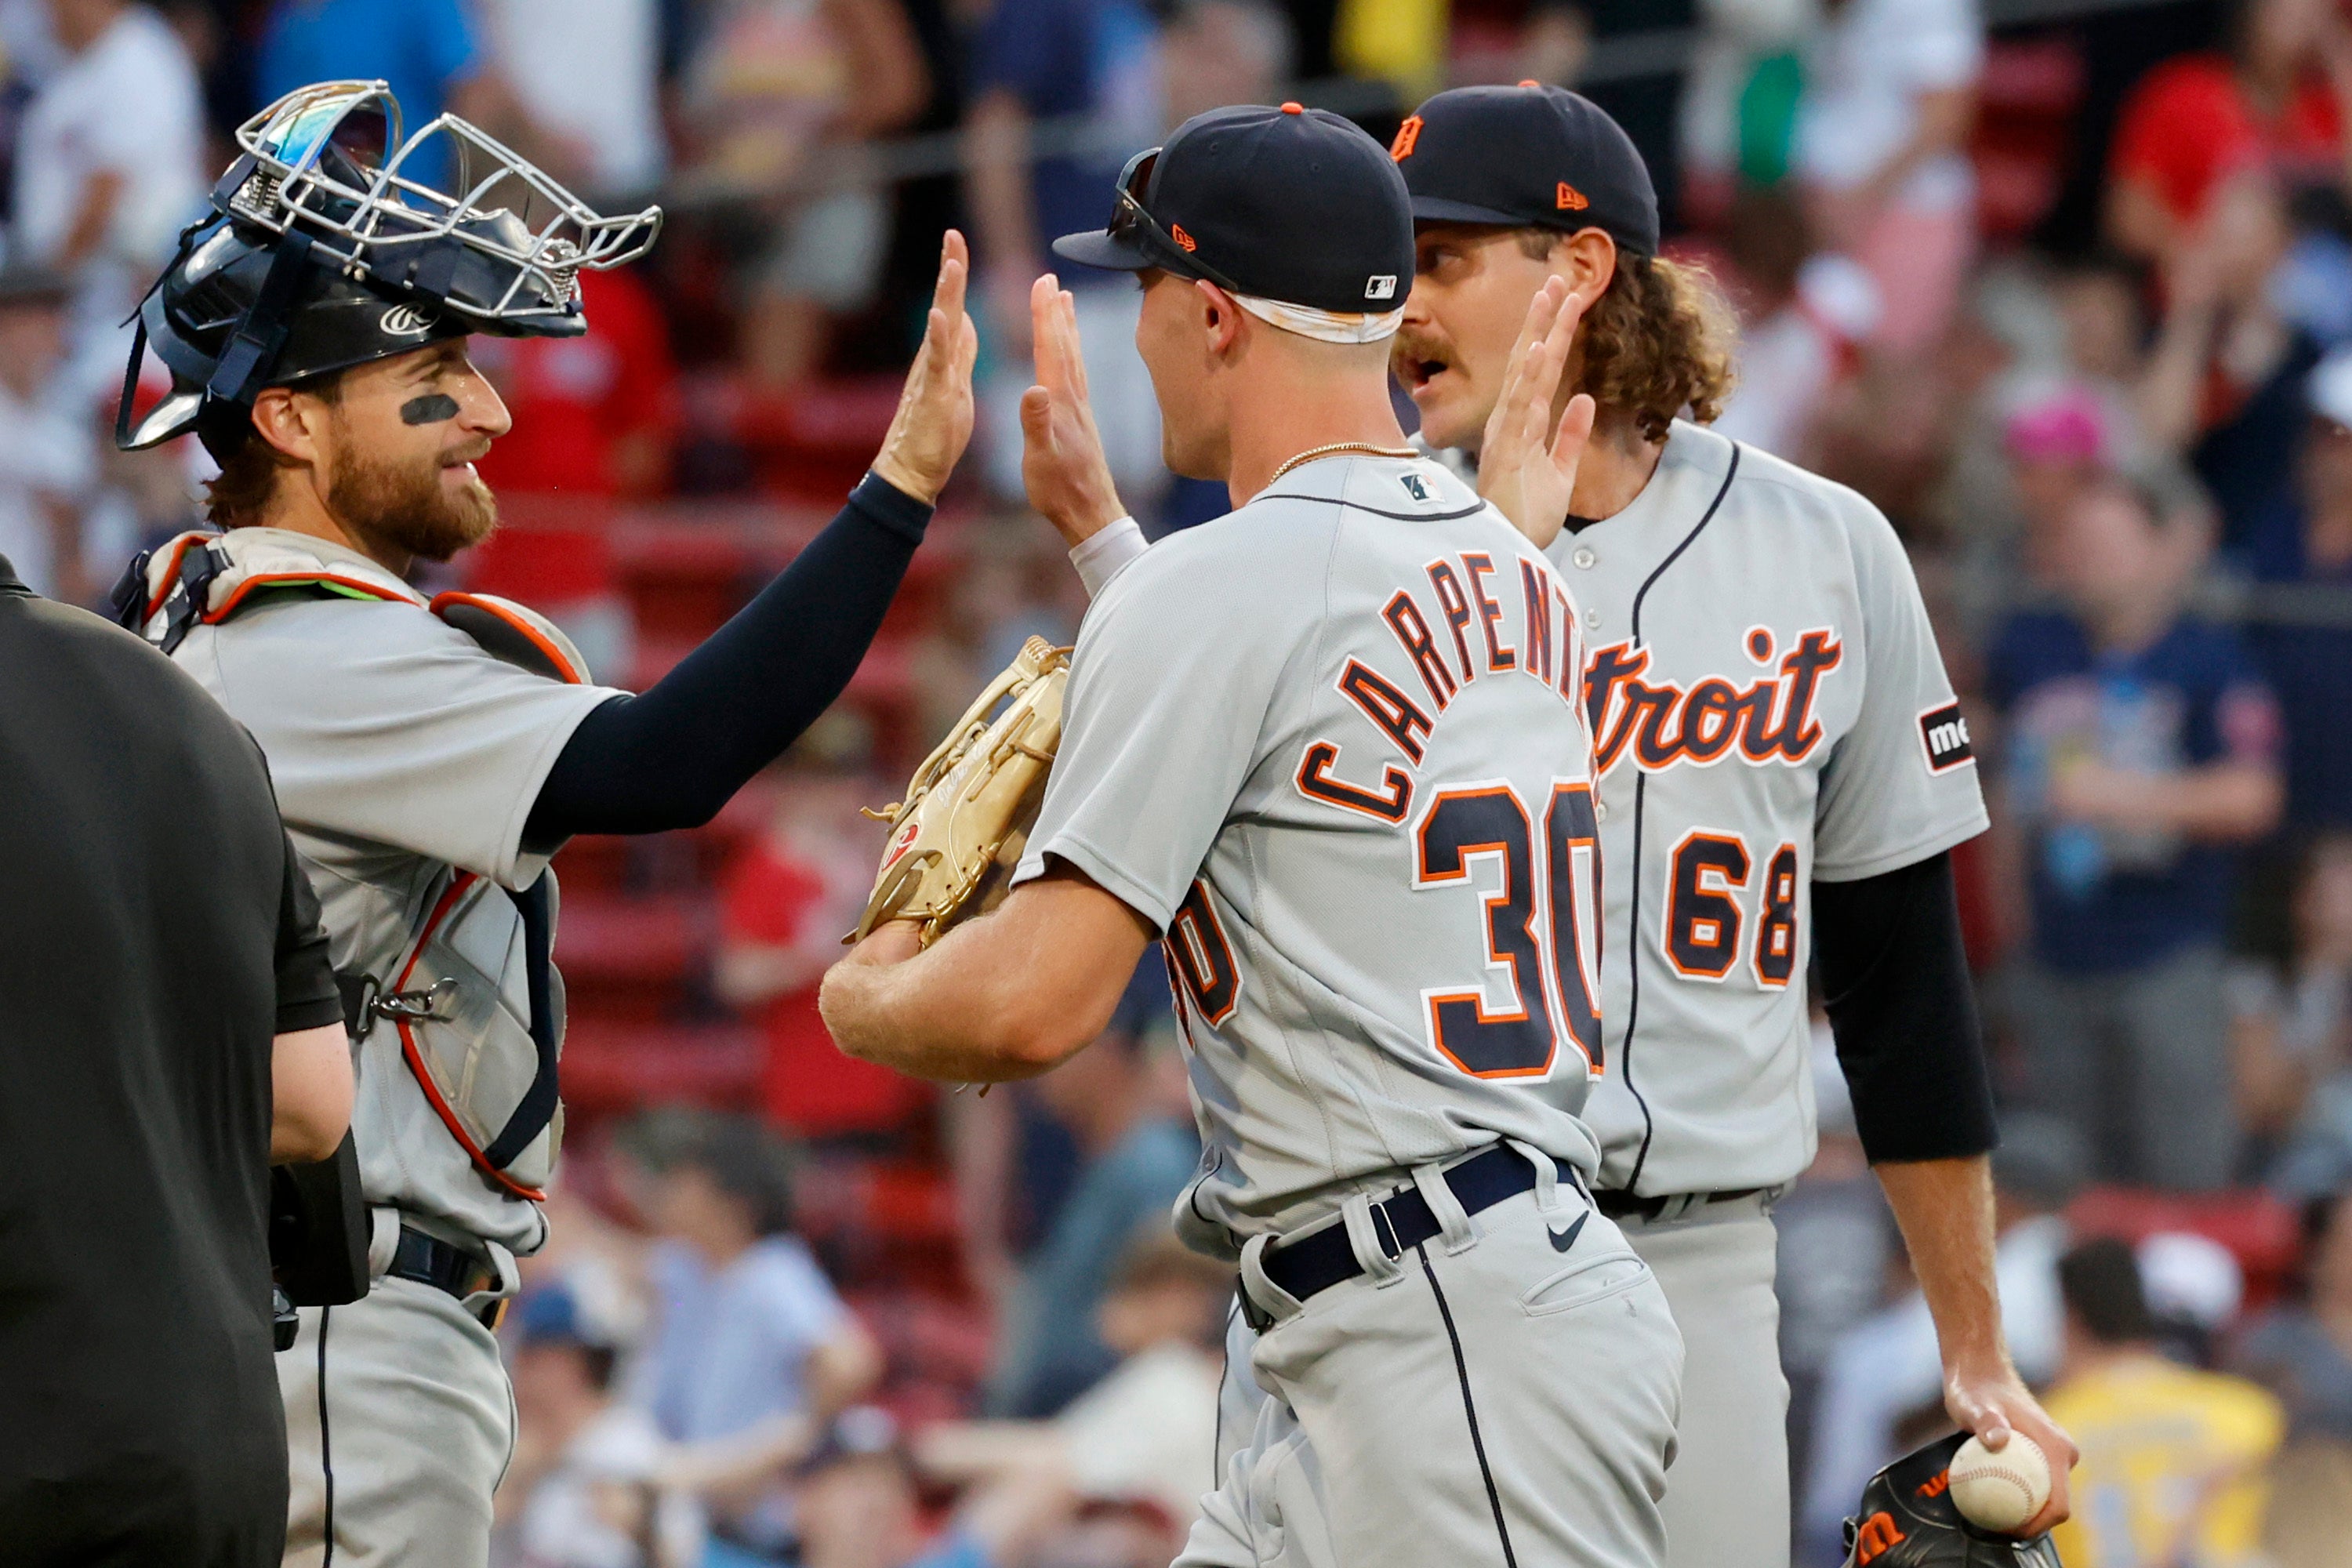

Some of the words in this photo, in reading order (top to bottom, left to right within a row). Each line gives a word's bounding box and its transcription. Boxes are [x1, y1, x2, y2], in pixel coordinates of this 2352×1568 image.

[1293, 550, 1601, 827] CARPENT
[1584, 624, 1843, 777] troit
[1162, 877, 1244, 1051] 0
[1410, 776, 1606, 1083] 30
[1661, 826, 1798, 993] 68
